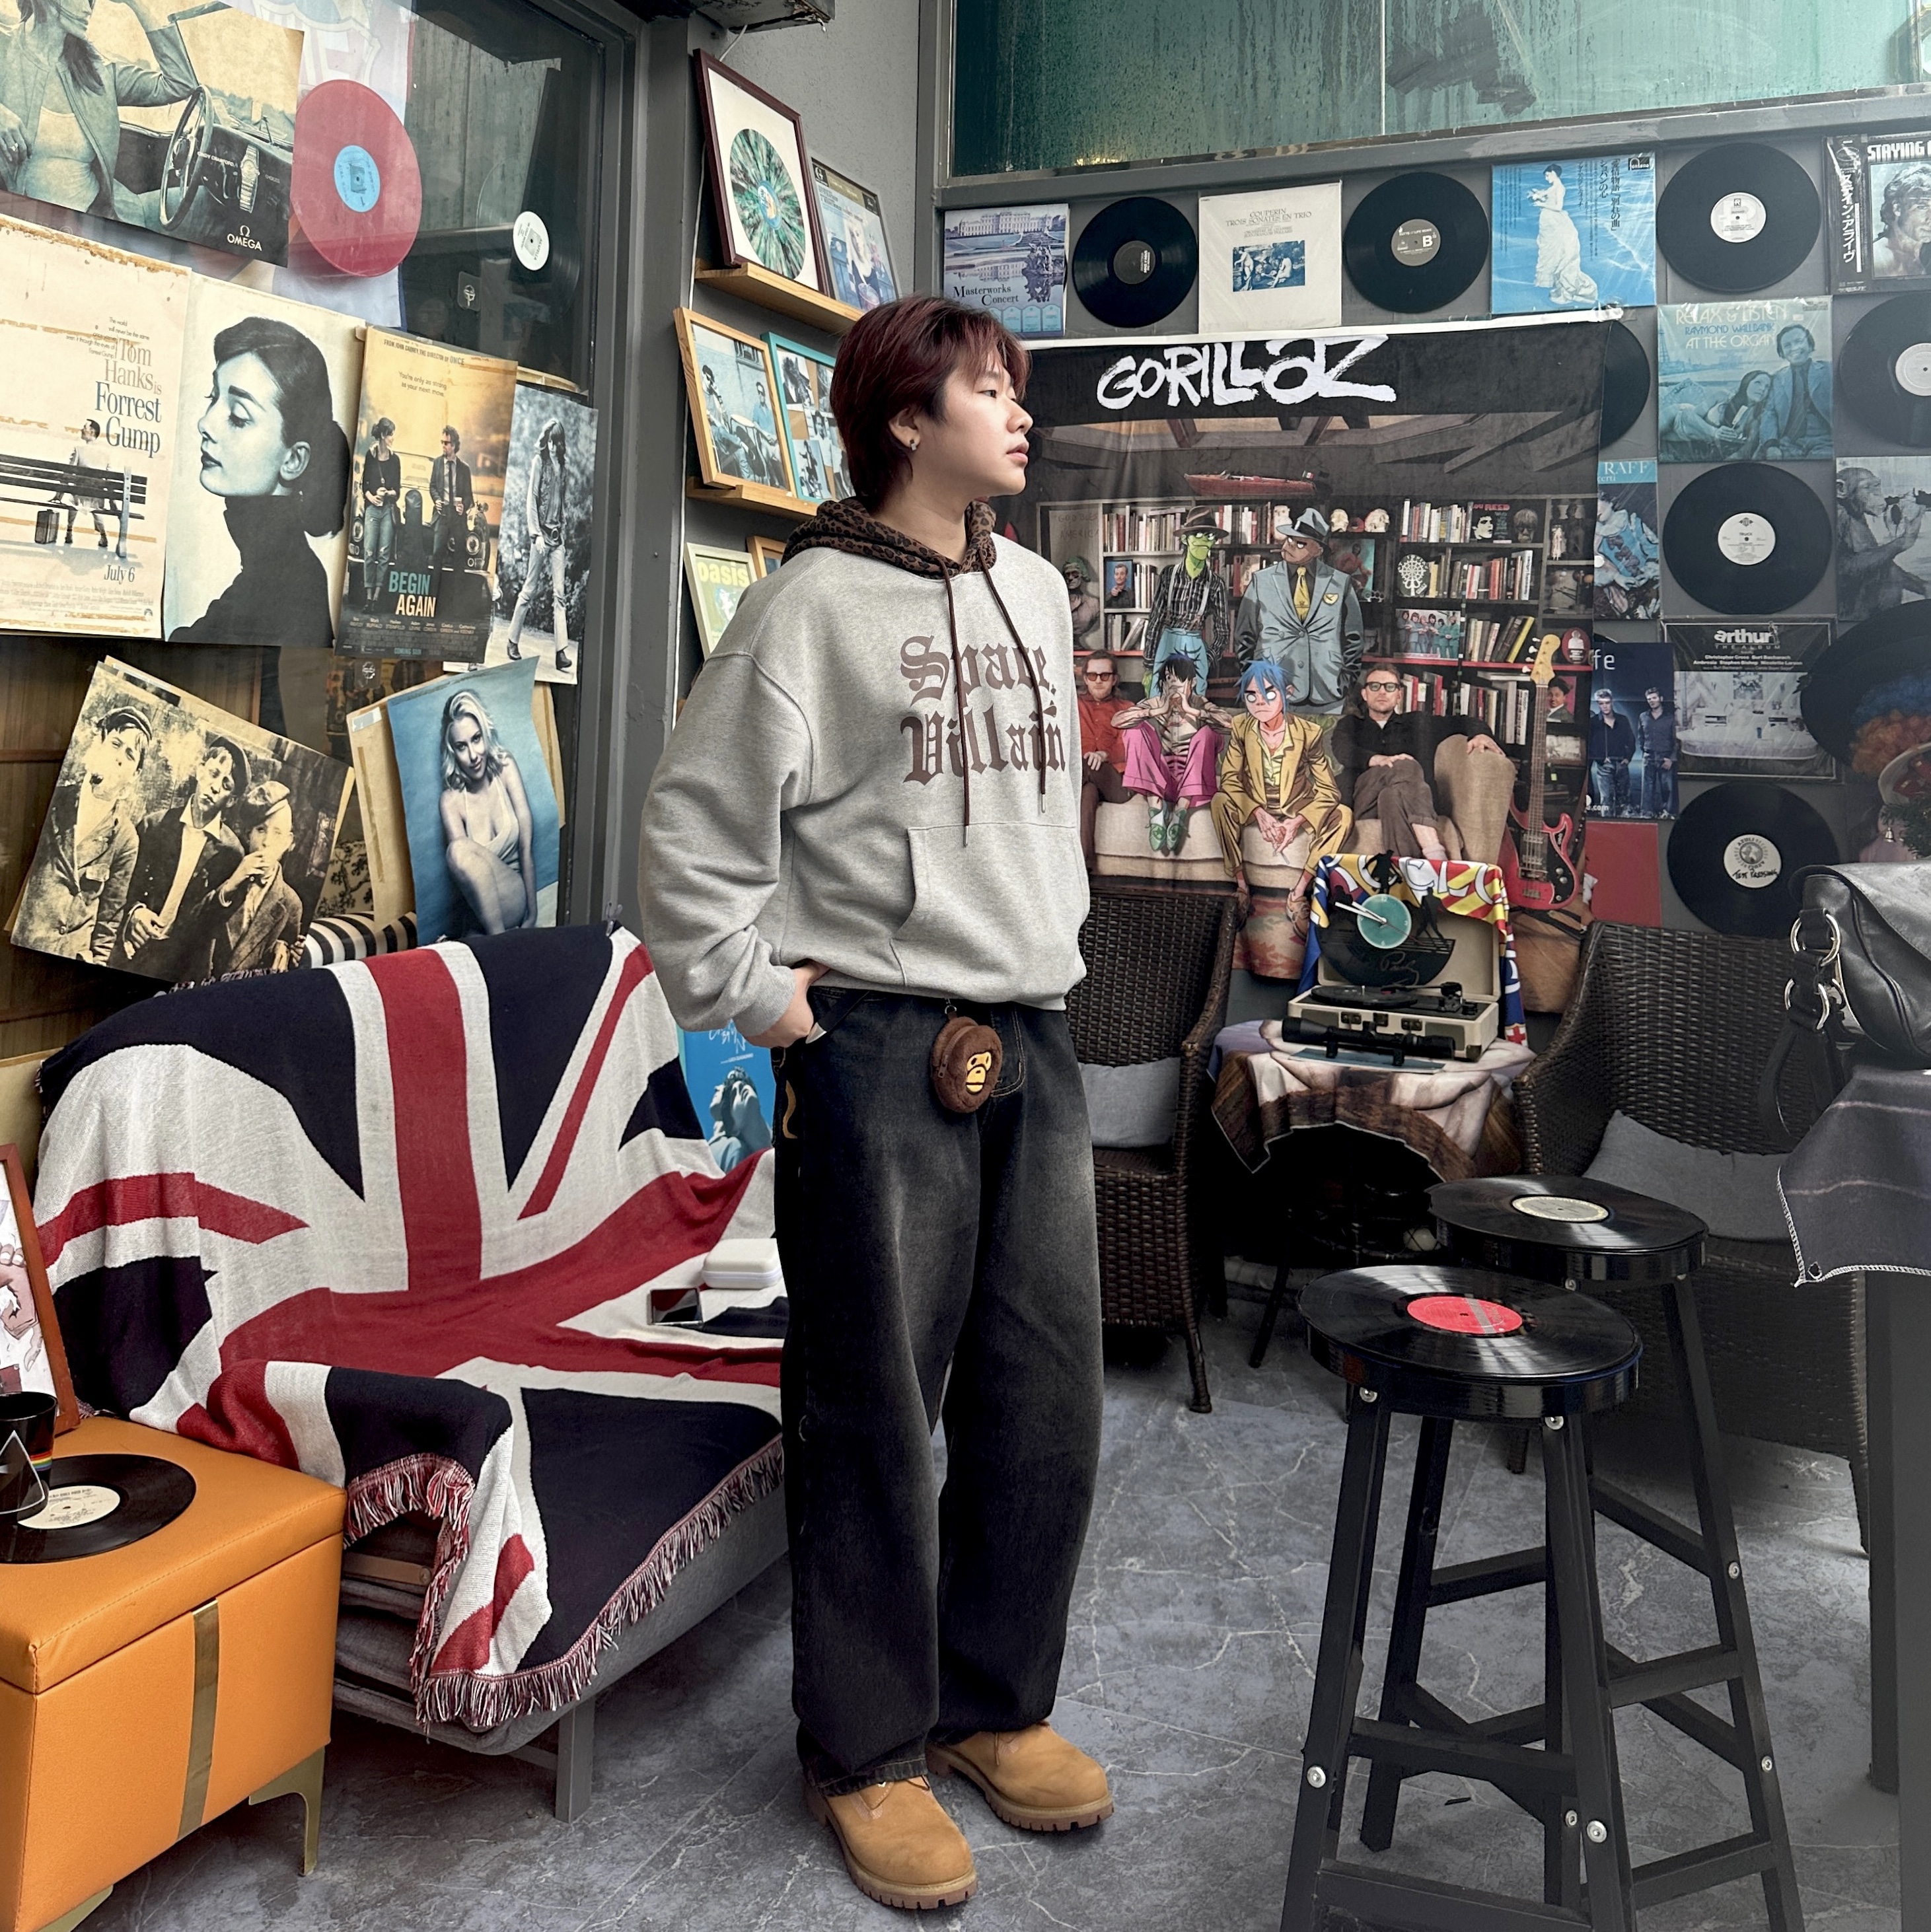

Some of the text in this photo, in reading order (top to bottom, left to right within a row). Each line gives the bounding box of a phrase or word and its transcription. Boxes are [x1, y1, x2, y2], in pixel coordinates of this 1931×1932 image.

[1867, 141, 1925, 163] STAYING
[1249, 208, 1287, 218] COUPERIN
[1249, 215, 1280, 224] SONATES
[1840, 174, 1855, 263] ステイン・アライヴ
[227, 233, 262, 251] OMEGA
[1422, 235, 1433, 247] B
[953, 284, 1011, 298] Masterworks
[981, 295, 1019, 306] Concert
[1676, 306, 1720, 325] RELAX
[1685, 322, 1775, 336] RAYMOND WALLBANK
[1686, 333, 1775, 349] AT THE ORGAN
[119, 338, 152, 367] Tom
[450, 355, 465, 365] ONCE
[104, 359, 163, 395] Hanks is
[414, 376, 424, 385] only
[95, 380, 162, 423] Forrest
[105, 417, 161, 458] Gump
[104, 565, 135, 585] July 6
[388, 571, 431, 595] BEGIN
[696, 561, 750, 588] oasis
[396, 594, 437, 618] AGAIN
[1714, 628, 1773, 643] arthur
[1593, 649, 1615, 670] fe
[900, 703, 1066, 786] Villain
